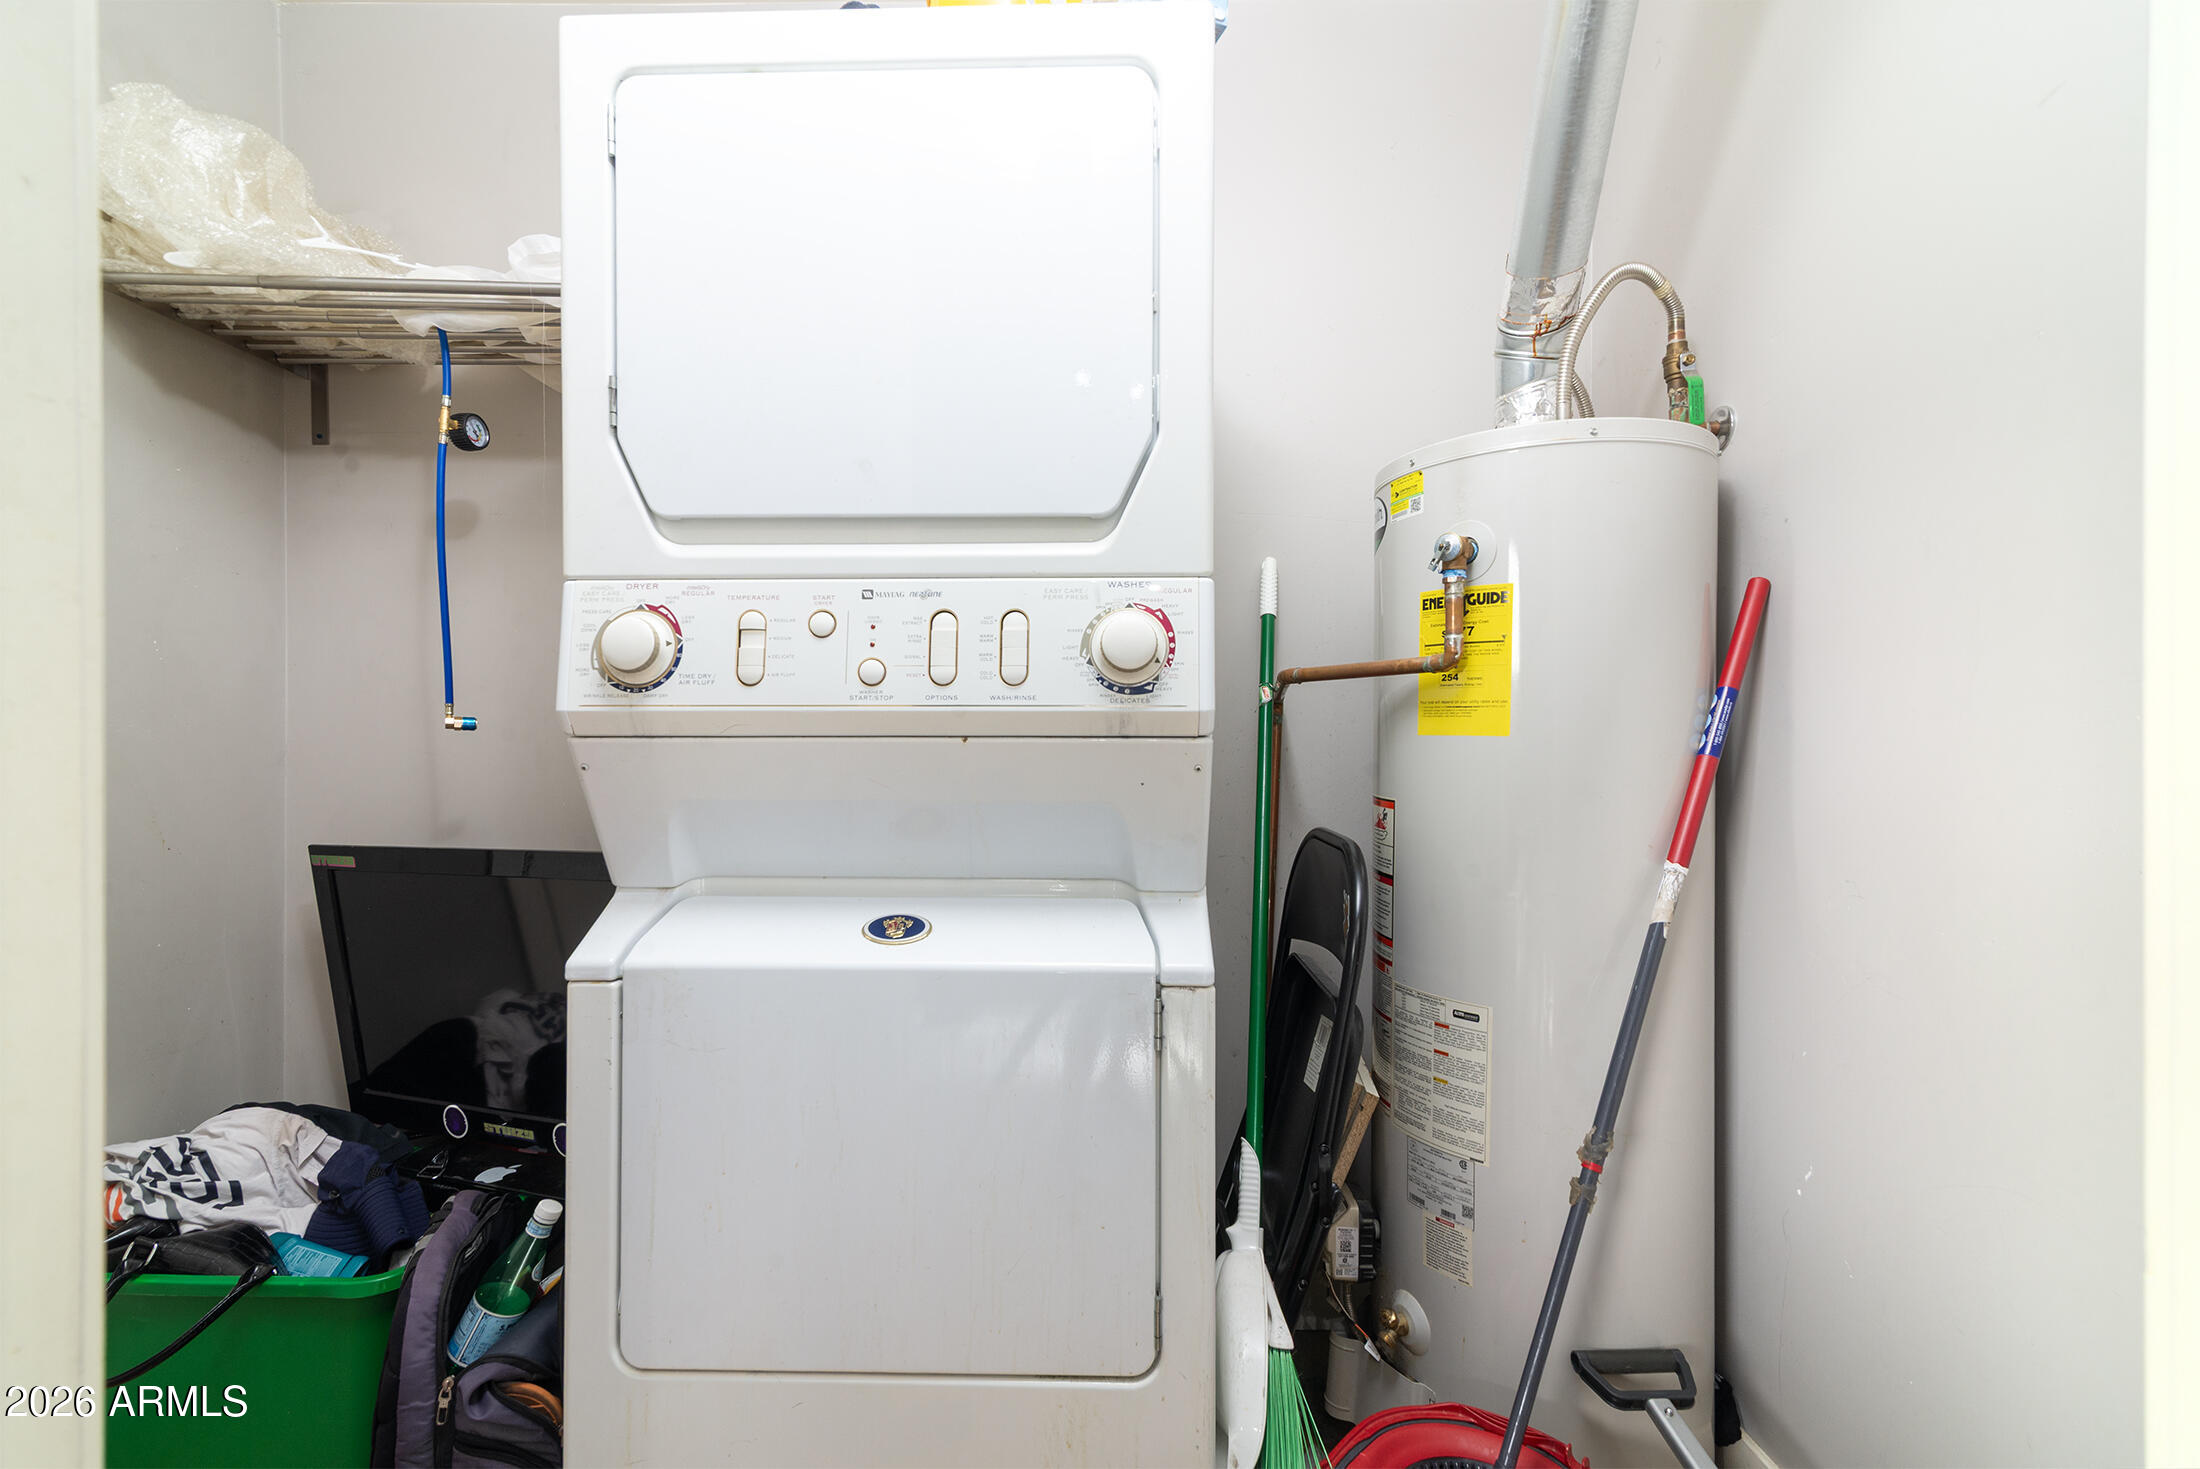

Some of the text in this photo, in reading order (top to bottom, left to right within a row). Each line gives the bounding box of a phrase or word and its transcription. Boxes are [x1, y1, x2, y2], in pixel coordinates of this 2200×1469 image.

[626, 582, 660, 591] DRYER
[875, 591, 906, 599] MAYTAG
[1422, 591, 1508, 611] ENEGUIDE
[1441, 673, 1458, 682] 254
